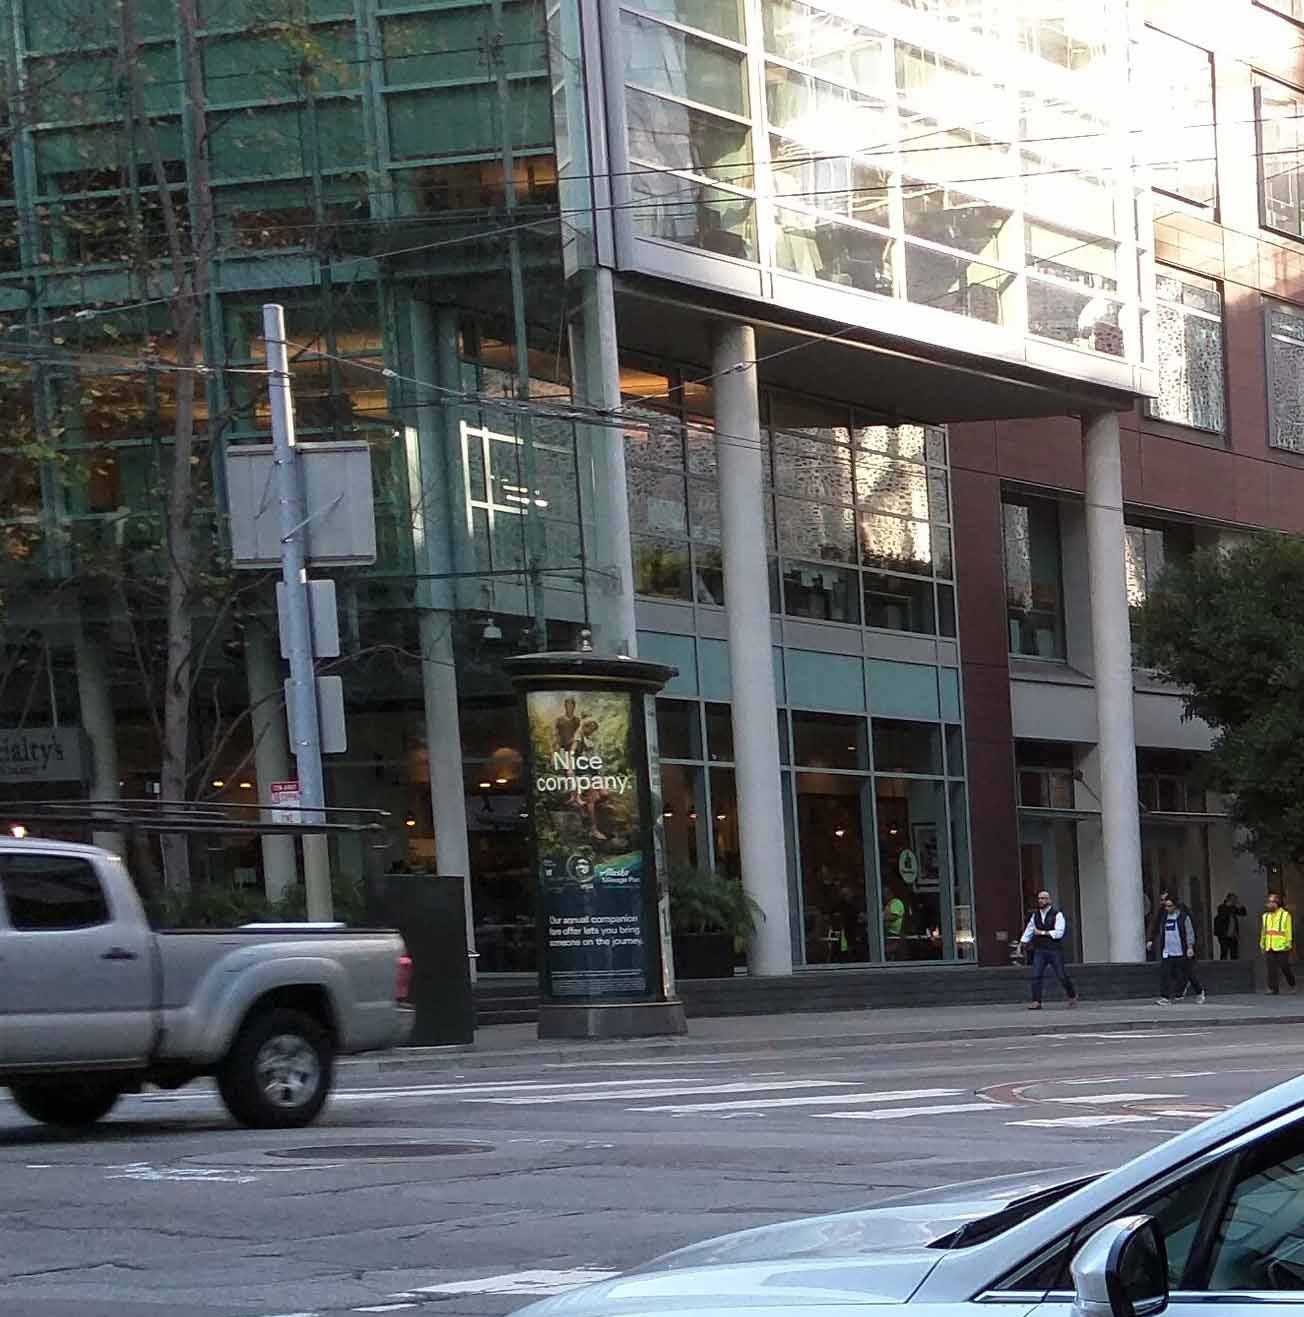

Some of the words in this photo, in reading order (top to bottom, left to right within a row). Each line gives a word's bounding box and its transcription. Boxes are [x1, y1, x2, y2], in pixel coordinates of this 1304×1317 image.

[553, 750, 603, 770] Nice
[601, 927, 618, 936] you
[619, 925, 640, 936] bring
